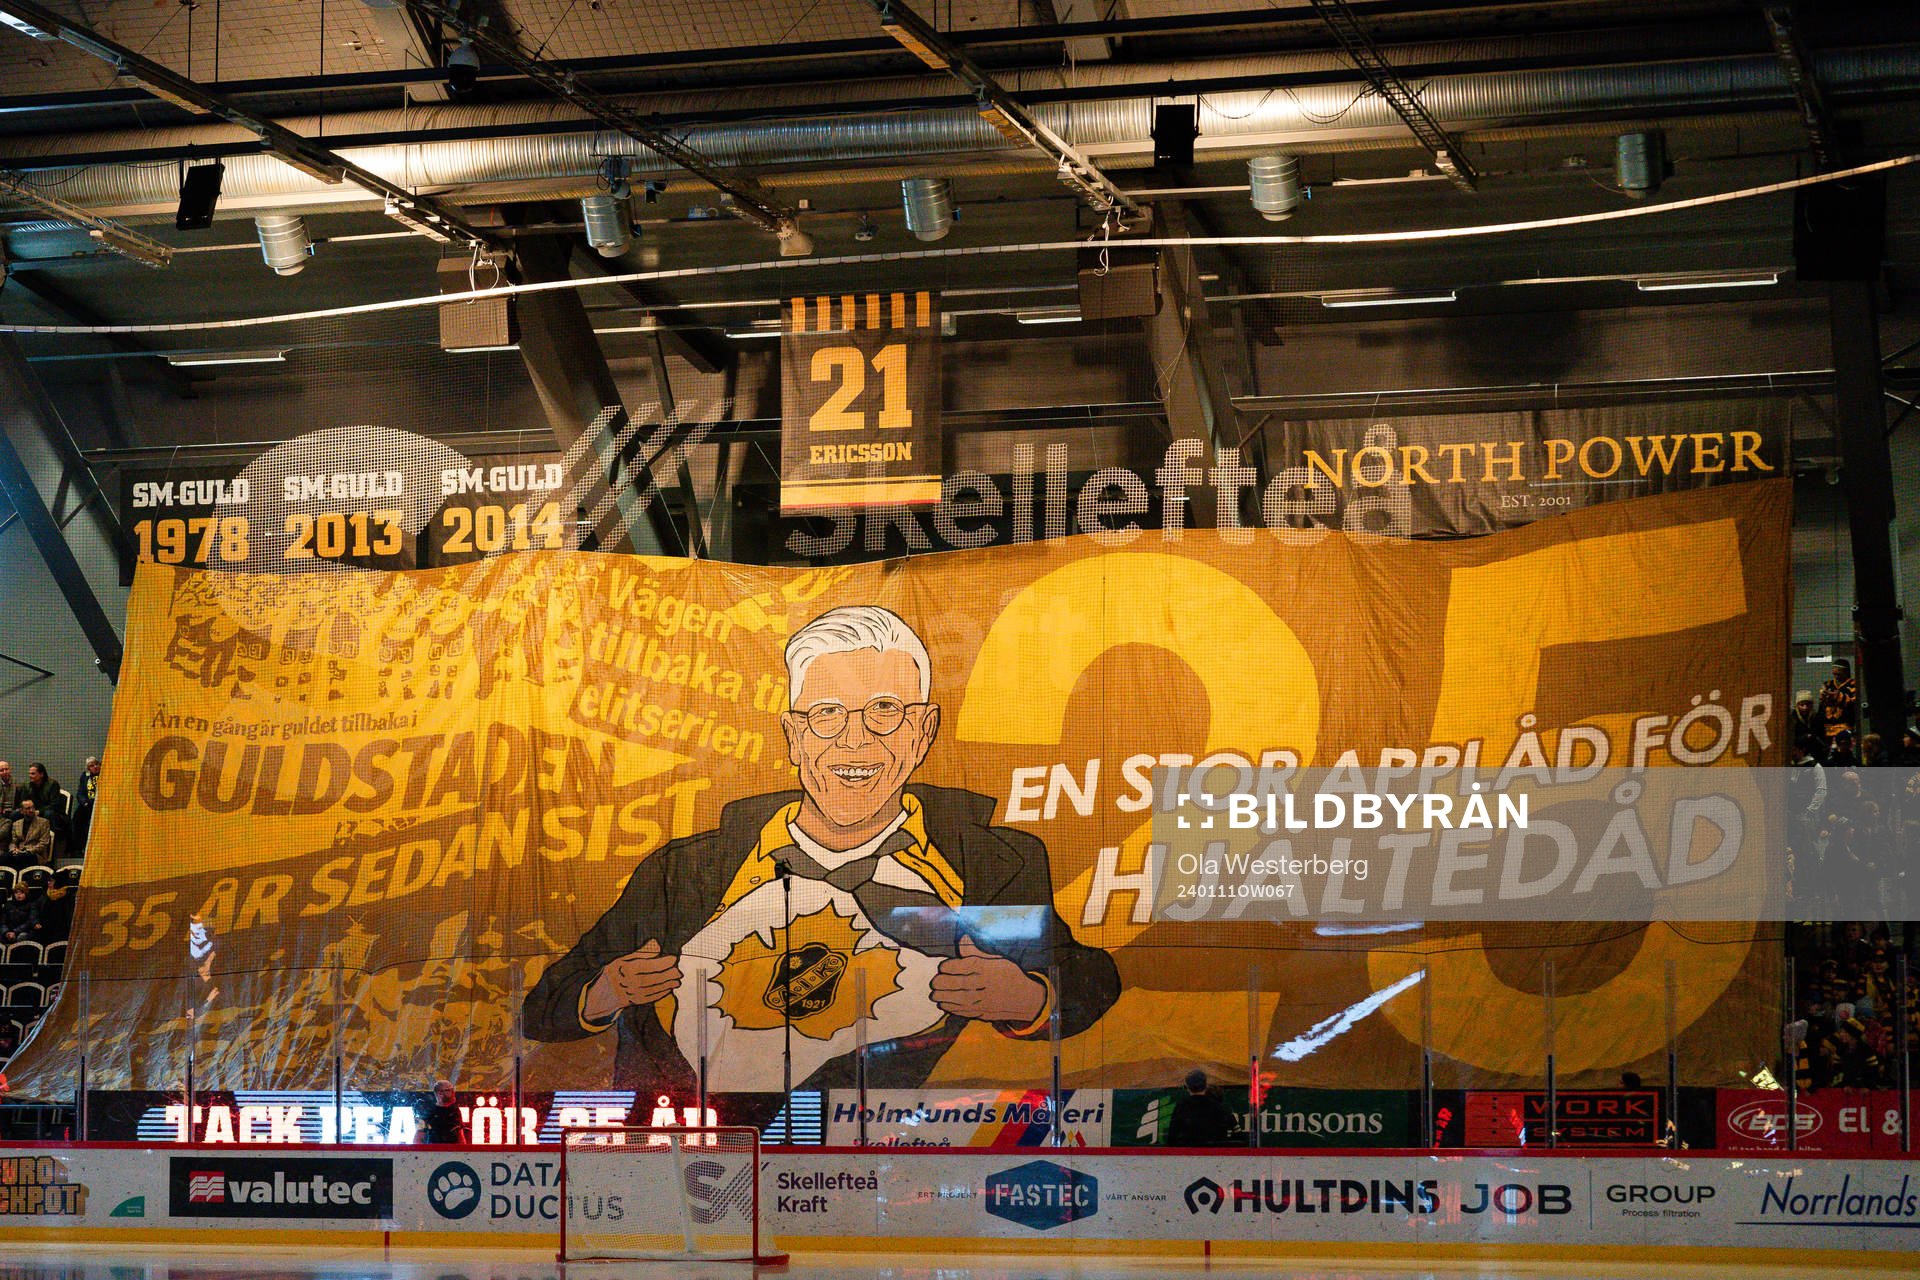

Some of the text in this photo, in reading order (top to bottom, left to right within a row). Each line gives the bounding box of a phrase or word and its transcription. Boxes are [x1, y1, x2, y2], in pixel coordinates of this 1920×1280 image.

[808, 343, 913, 432] 21
[808, 441, 913, 466] ERICSSON
[1303, 430, 1774, 489] NORTH POWER
[132, 478, 249, 509] SM-GULD
[283, 471, 403, 502] SM-GULD
[441, 462, 564, 496] SM-GULD
[1500, 494, 1572, 508] EST. 2001
[132, 514, 249, 564] 1978
[283, 508, 404, 559] 2013
[440, 501, 565, 554] 2014
[609, 567, 734, 644] Vägen
[590, 621, 790, 714] tillbaka ti
[151, 703, 419, 741] Än en gång är guldet tillbaka i
[138, 721, 616, 818] GULDSTADEN
[1003, 689, 1773, 823] EN STOR APPLÅD FÖR
[88, 778, 713, 957] 35 ÅR SEDAN SIST
[1081, 778, 1744, 926] HJÄLTEDÅD
[801, 999, 826, 1009] 1921
[165, 1105, 304, 1144] TACK
[832, 1101, 997, 1124] Holmlunds
[1529, 1099, 1650, 1116] WORK
[1838, 1106, 1903, 1135] El &
[0, 1156, 56, 1185] URO
[777, 1170, 878, 1191] Skellefteå
[228, 1171, 372, 1205] valutec
[777, 1196, 828, 1213] Kraft
[995, 1183, 1089, 1207] FASTEC
[1233, 1179, 1441, 1214] HULTDINS
[1460, 1183, 1573, 1215] JOB
[1606, 1184, 1716, 1204] GROUP
[1760, 1174, 1917, 1216] Norrlands
[1622, 1207, 1701, 1218] Process filtration
